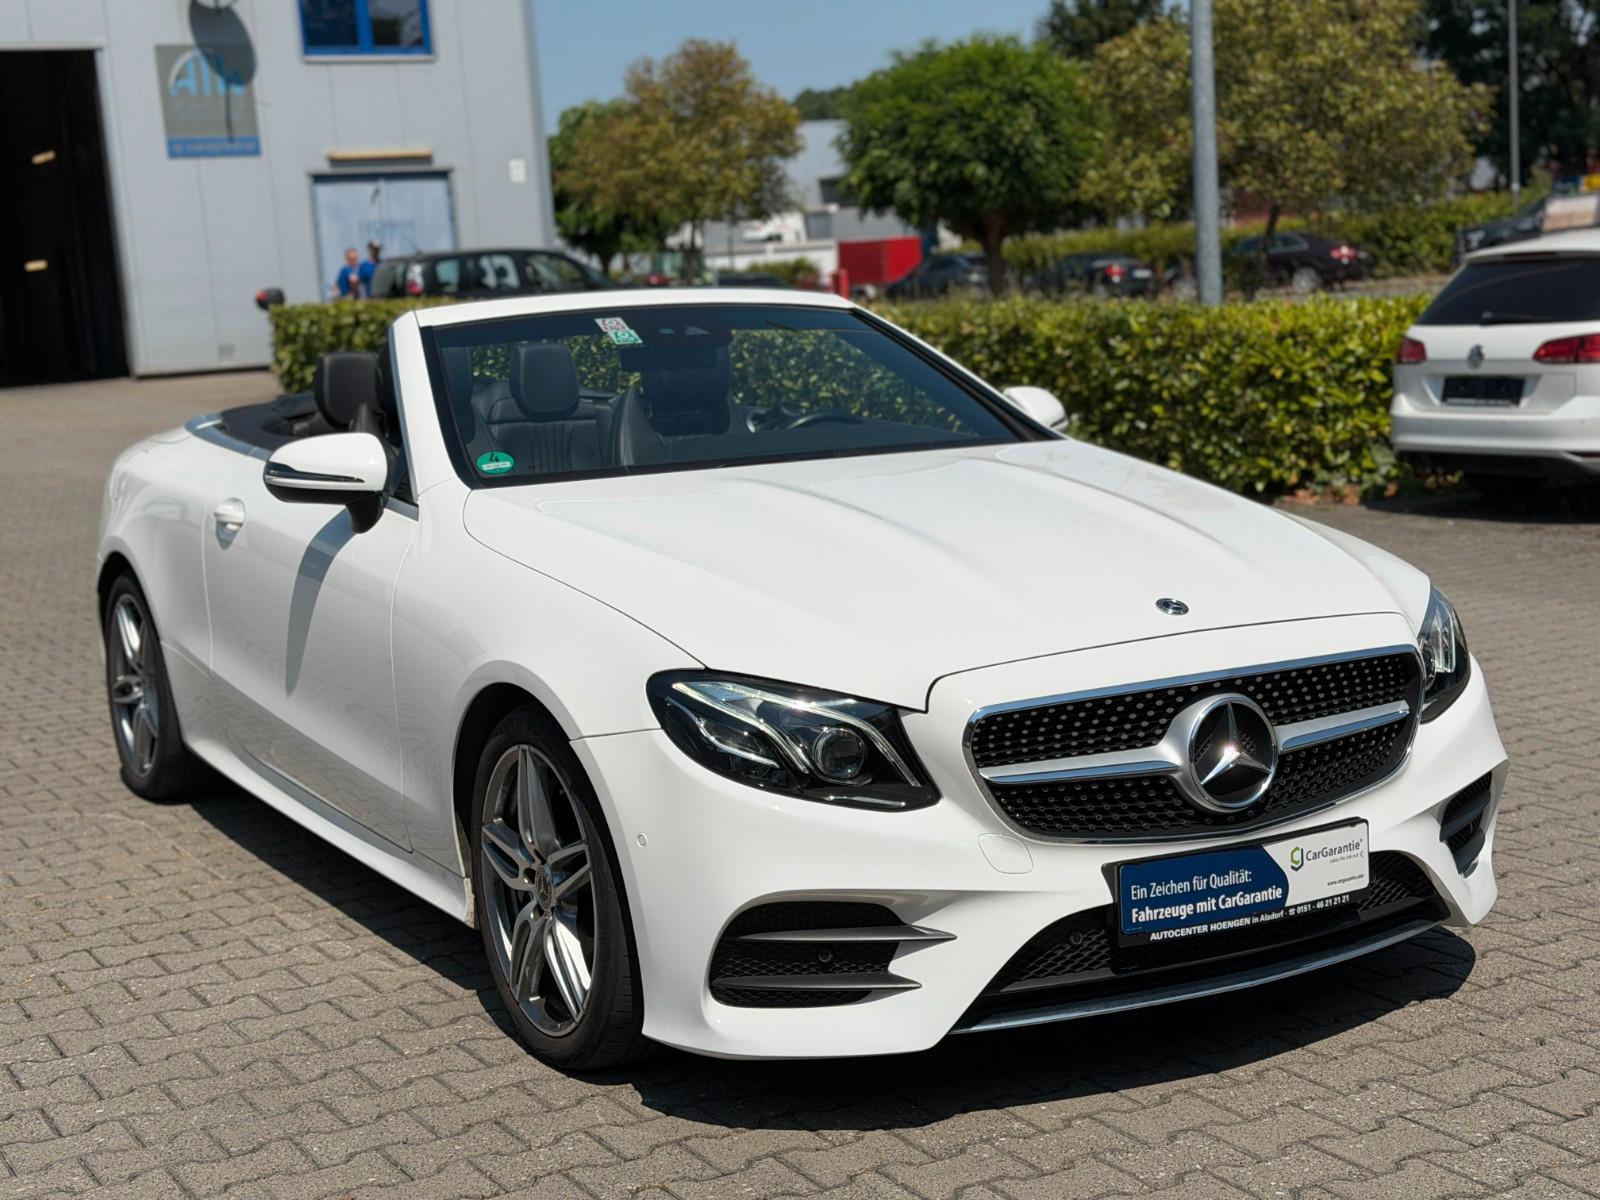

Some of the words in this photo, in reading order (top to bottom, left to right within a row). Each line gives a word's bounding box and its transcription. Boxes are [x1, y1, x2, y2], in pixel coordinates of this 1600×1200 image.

[1305, 840, 1360, 861] CarGarantie
[1131, 884, 1147, 900] Ein
[1150, 878, 1191, 898] Zeichen
[1193, 875, 1208, 891] für
[1209, 869, 1252, 889] Qualität:
[1132, 903, 1194, 923] Fahrzeuge
[1196, 897, 1217, 913] mit
[1218, 885, 1283, 909] CarGarantie
[1150, 924, 1209, 941] AUTOCENTER
[1210, 917, 1251, 932] HOENGEN
[1252, 916, 1259, 924] in
[1260, 909, 1284, 922] Alsdorf
[1296, 904, 1311, 914] 0151
[1333, 896, 1341, 904] 21
[1342, 894, 1350, 902] 21
